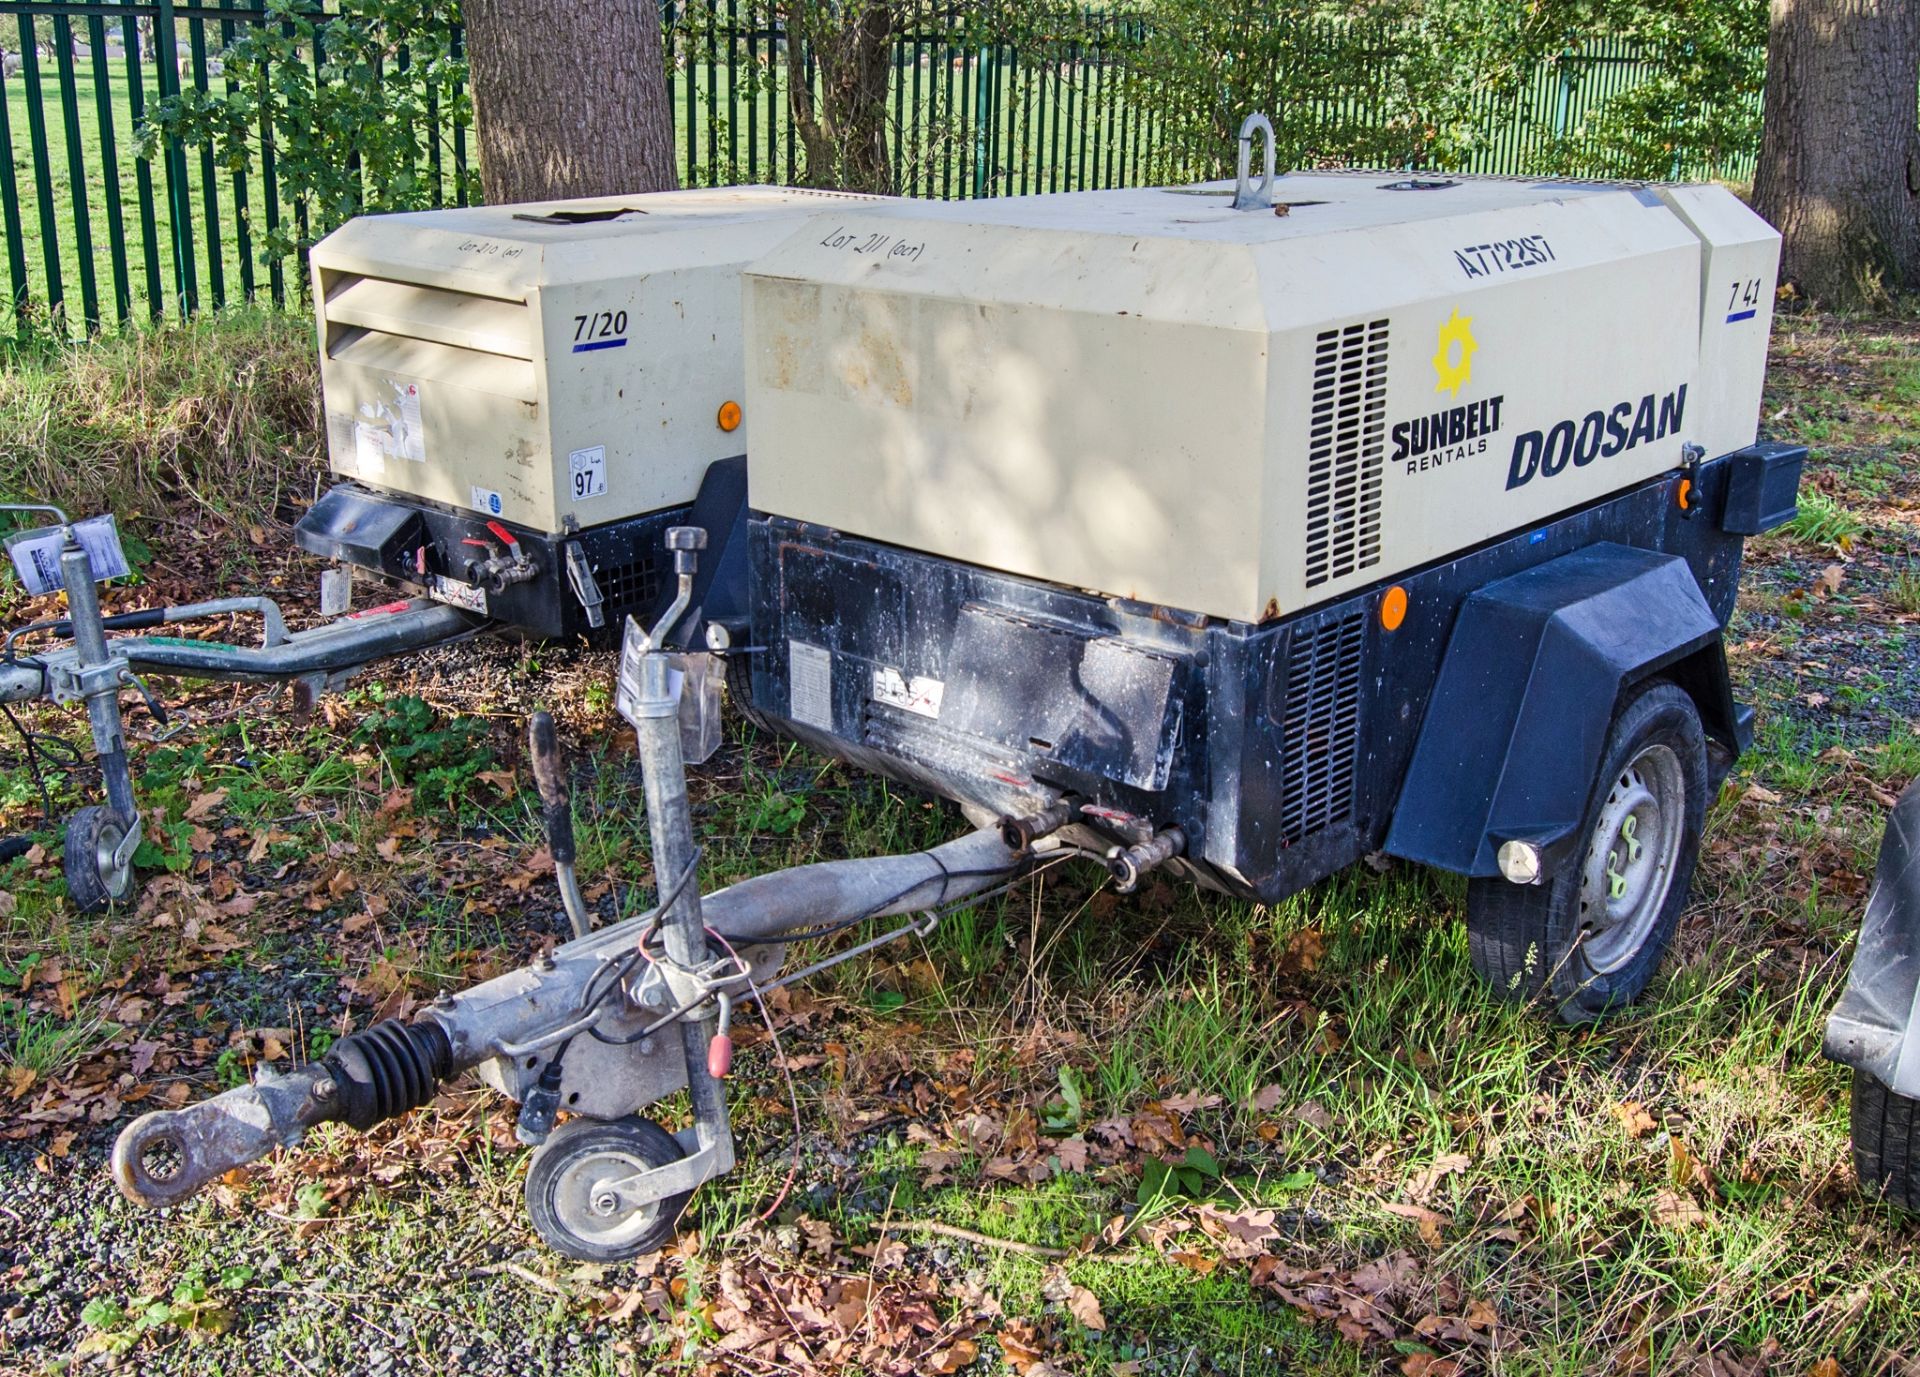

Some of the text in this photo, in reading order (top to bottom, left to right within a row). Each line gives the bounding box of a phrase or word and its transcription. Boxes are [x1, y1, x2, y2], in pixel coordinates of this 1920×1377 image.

[853, 233, 890, 254] 211
[574, 310, 628, 342] 7/20
[1390, 394, 1505, 461] SUNBELT
[1505, 383, 1688, 492] DOOSAN
[1406, 438, 1488, 475] RENTALS
[575, 468, 594, 496] 97
